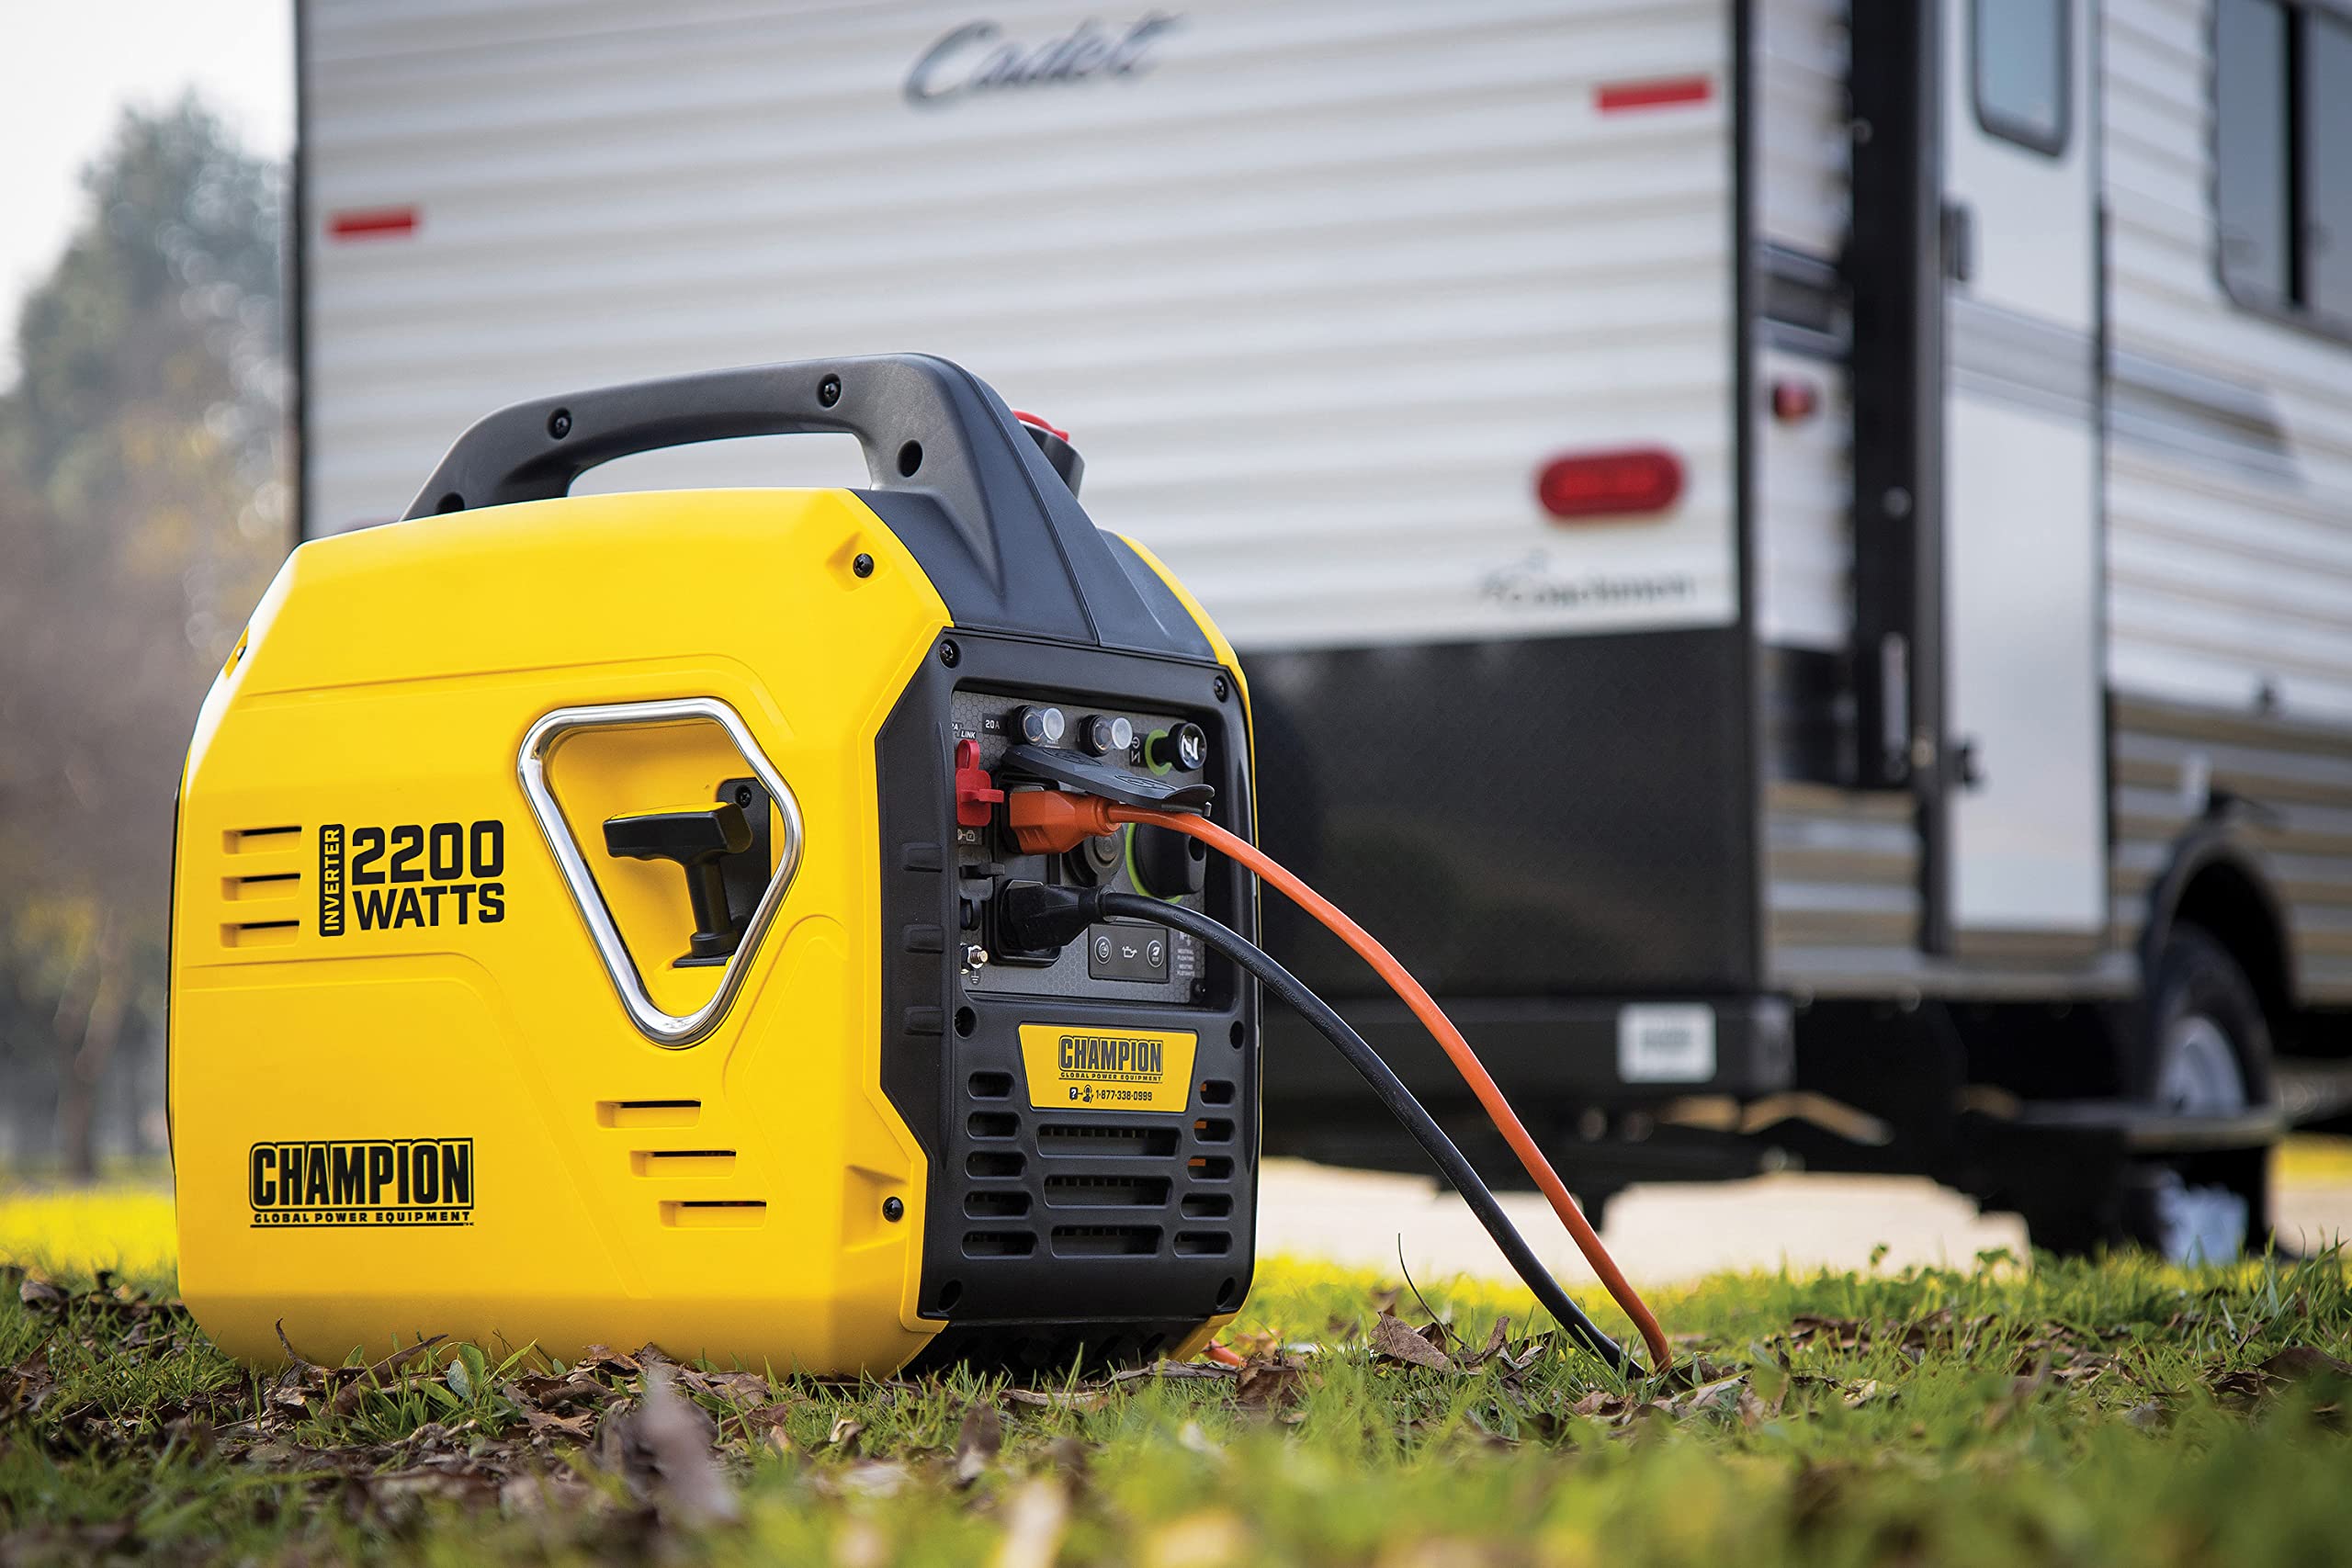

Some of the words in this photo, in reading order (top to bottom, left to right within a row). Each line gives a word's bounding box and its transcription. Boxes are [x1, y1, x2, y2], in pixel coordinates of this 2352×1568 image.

[903, 11, 1180, 108] Cadet
[960, 729, 977, 739] LINK
[985, 719, 1001, 730] 20A
[352, 819, 504, 885] 2200
[324, 829, 341, 932] INVERTER
[352, 883, 505, 931] WATTS
[1059, 1037, 1162, 1073] CHAMPION
[253, 1144, 470, 1206] CHAMPION
[254, 1213, 310, 1224] GLOBAL
[314, 1213, 368, 1223] POWER
[375, 1212, 470, 1223] EQUIPMENT
